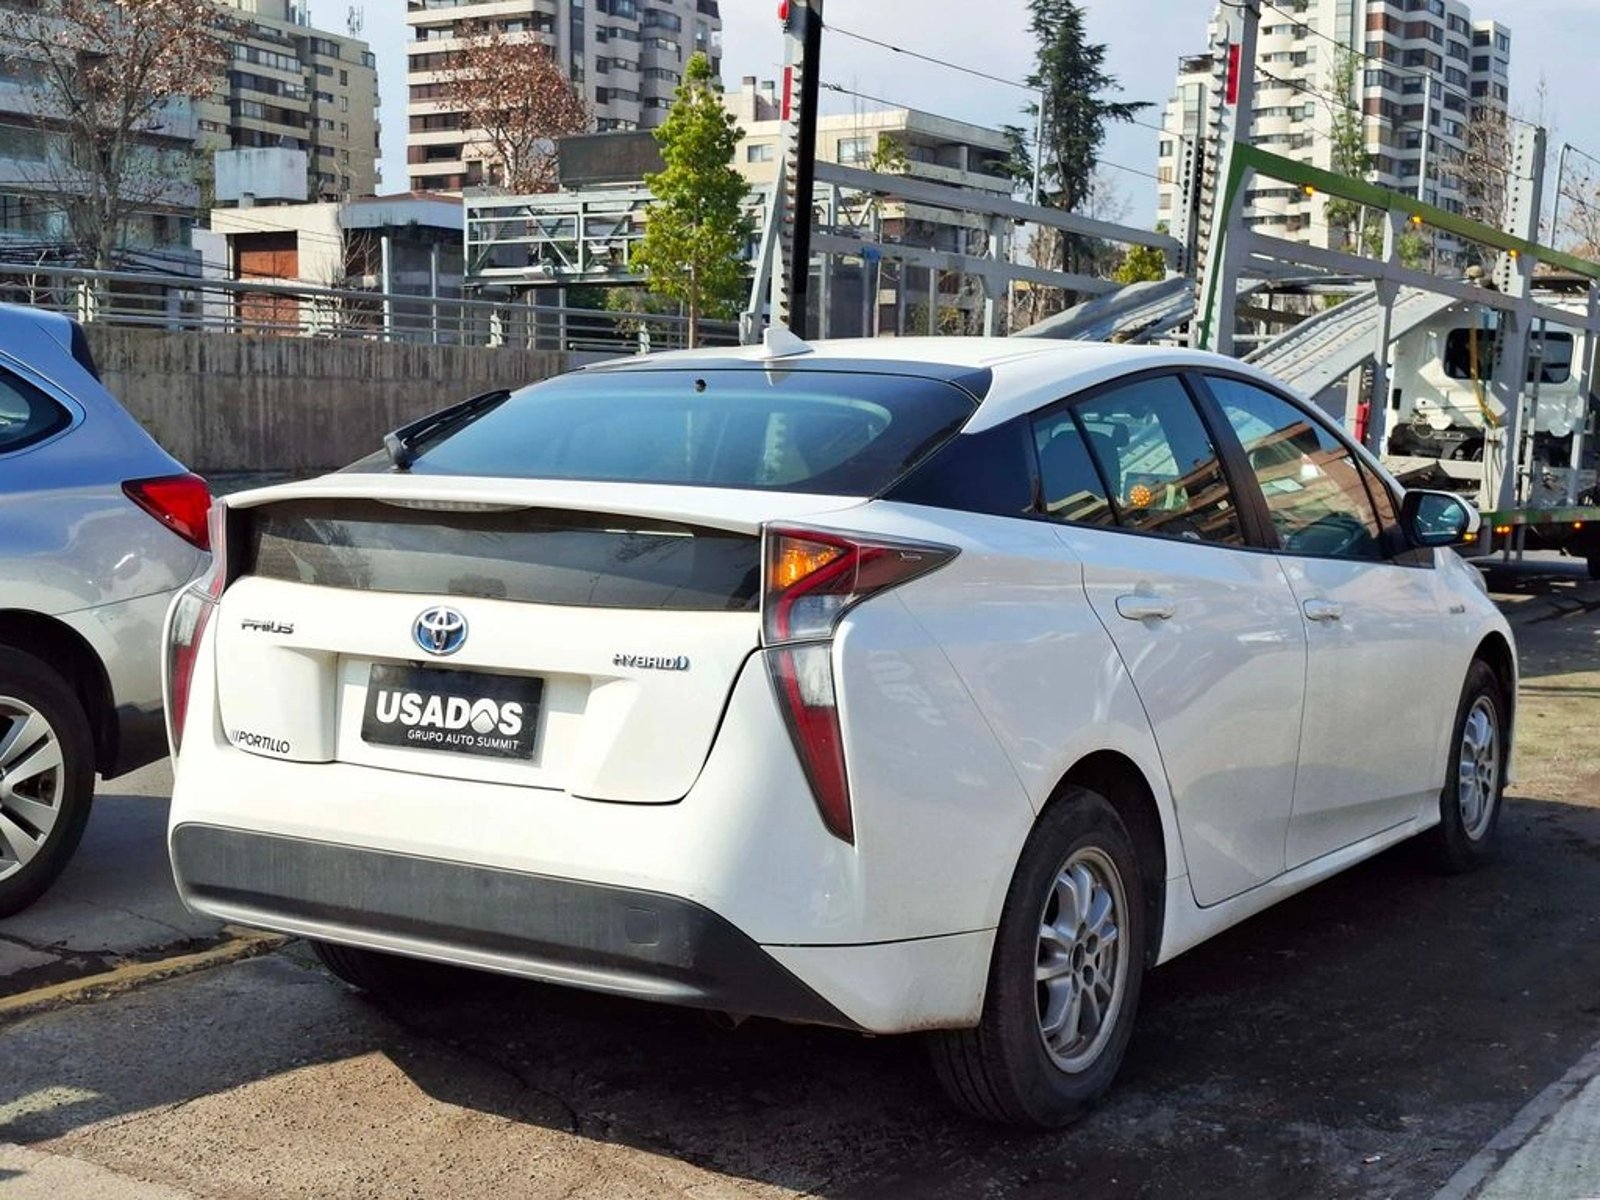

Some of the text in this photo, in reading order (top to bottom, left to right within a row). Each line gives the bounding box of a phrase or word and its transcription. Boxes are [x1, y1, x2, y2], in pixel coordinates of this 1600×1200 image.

[612, 653, 677, 670] HYBRID
[376, 690, 523, 736] USADOS
[239, 730, 290, 753] PORTILLO
[407, 729, 519, 750] GRUPO AUTO SUMMIT
